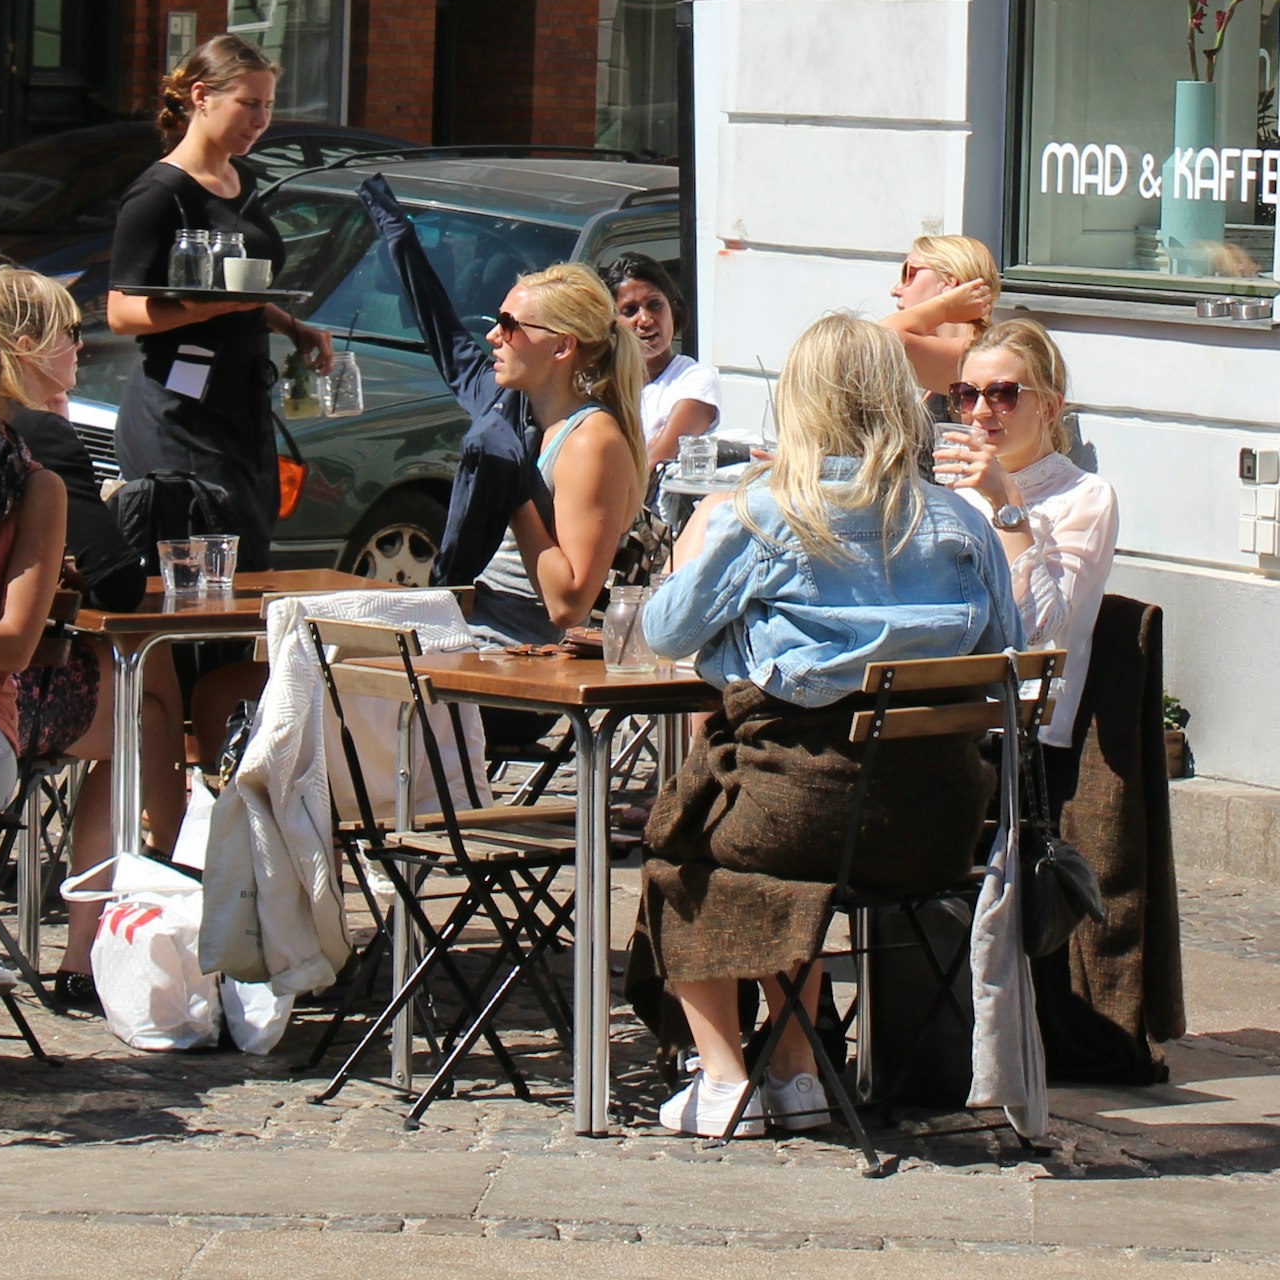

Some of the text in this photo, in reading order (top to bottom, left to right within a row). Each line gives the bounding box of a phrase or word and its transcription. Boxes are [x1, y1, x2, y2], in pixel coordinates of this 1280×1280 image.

[1041, 142, 1279, 205] MAD & KAFFE
